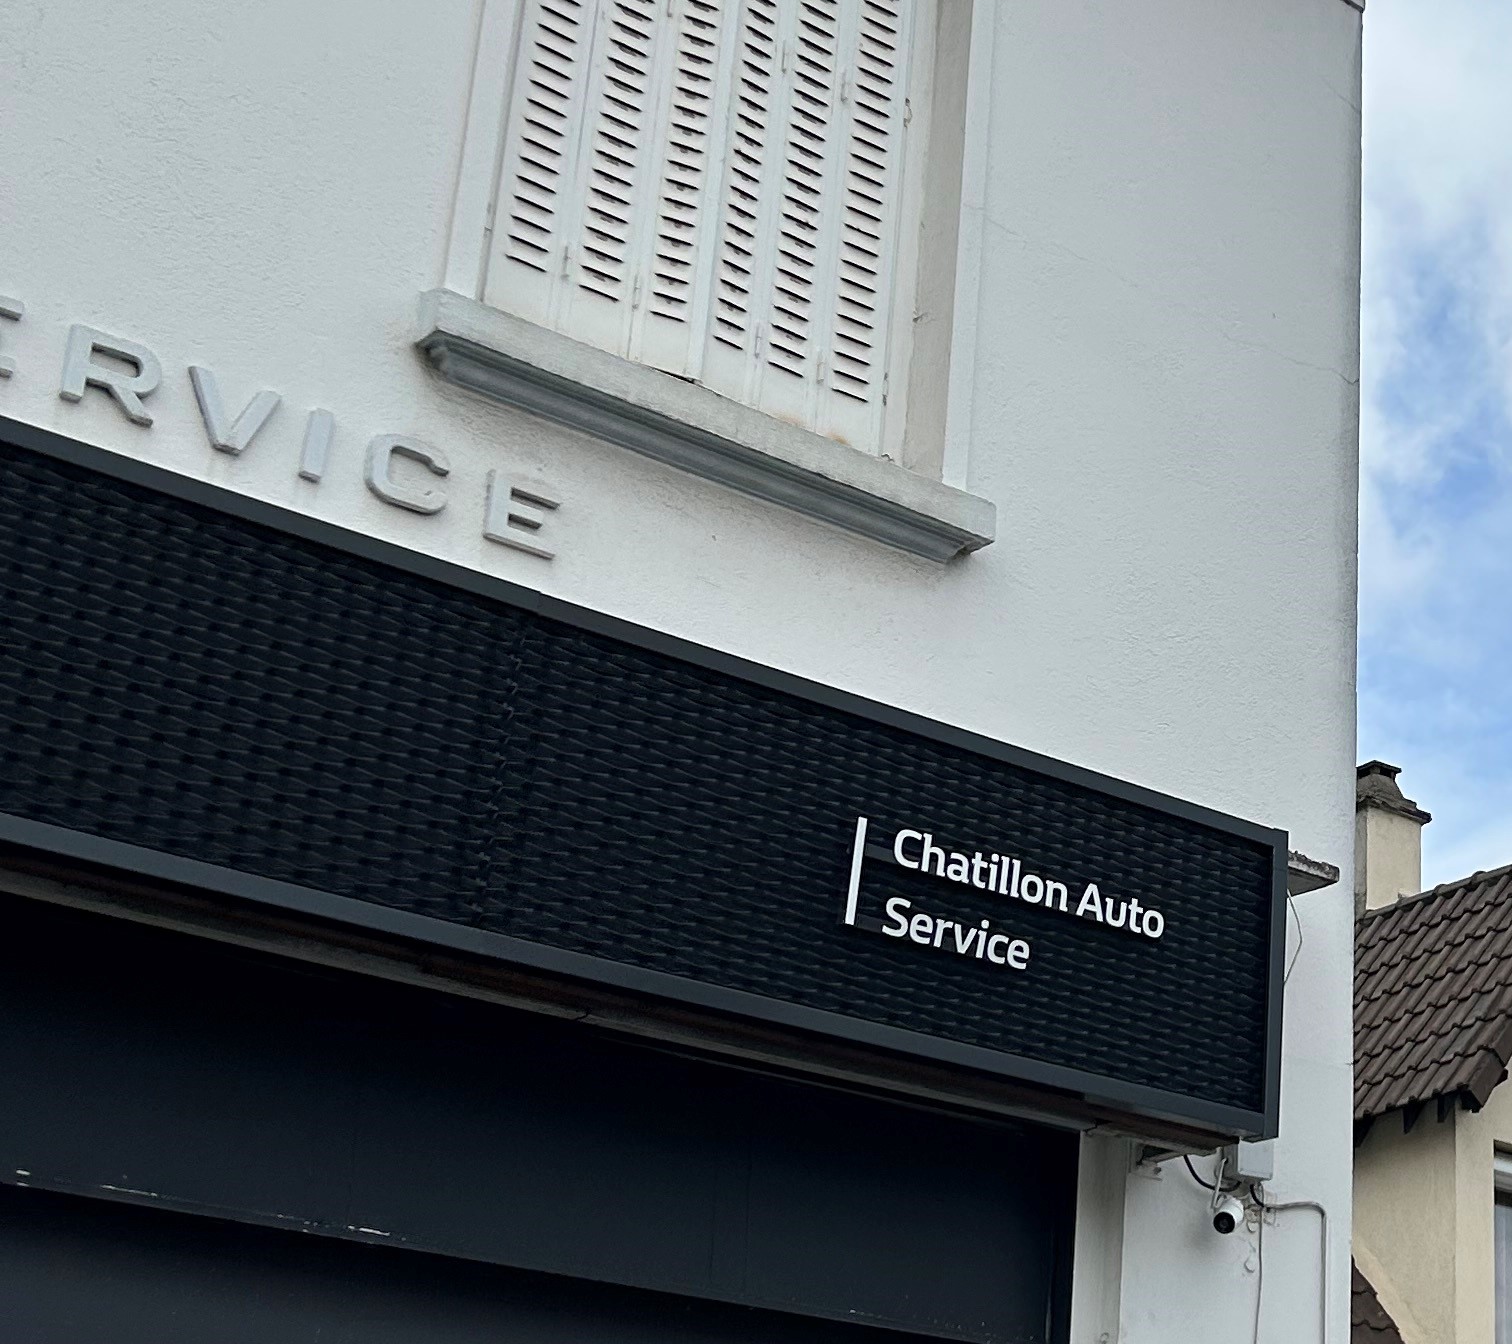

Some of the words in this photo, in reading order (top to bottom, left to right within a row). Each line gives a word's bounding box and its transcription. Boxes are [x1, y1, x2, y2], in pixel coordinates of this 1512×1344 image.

[0, 296, 561, 558] RVICE
[882, 897, 1030, 969] Service
[894, 829, 1068, 912] Chatillon
[1076, 883, 1165, 938] Auto
